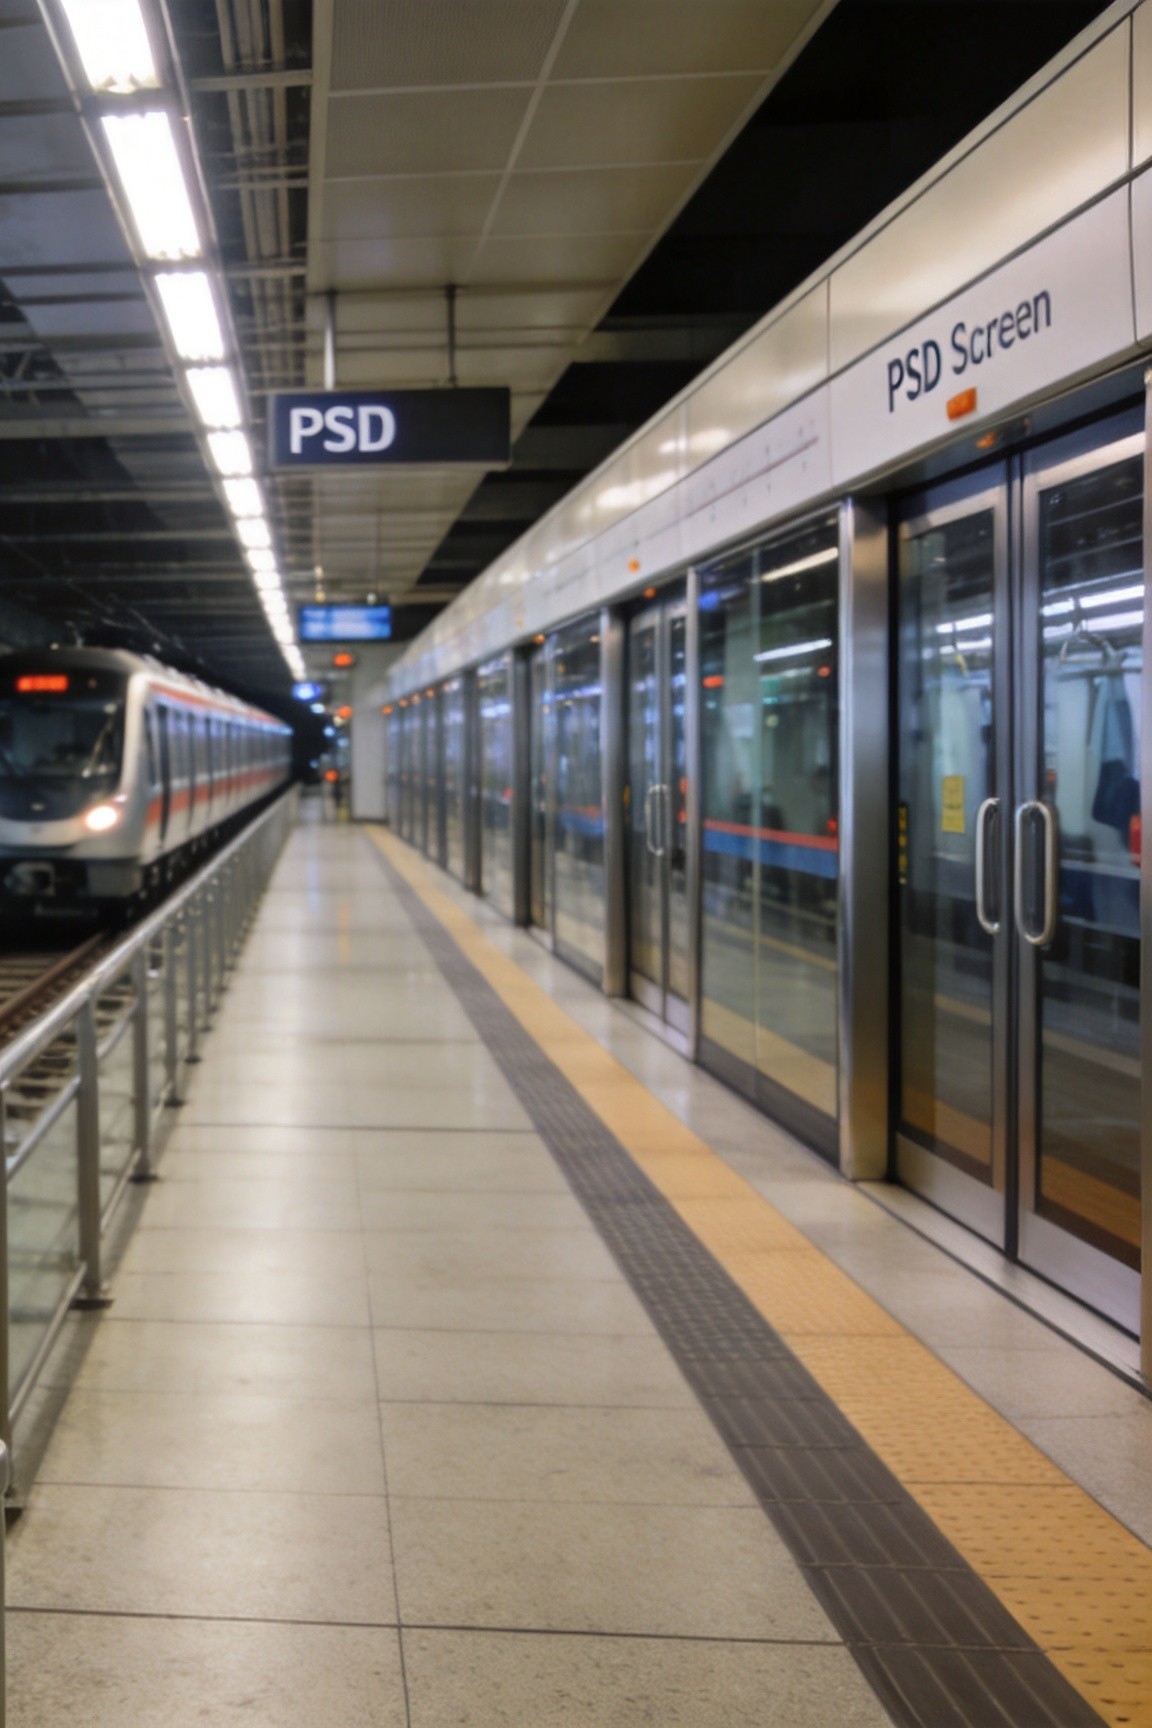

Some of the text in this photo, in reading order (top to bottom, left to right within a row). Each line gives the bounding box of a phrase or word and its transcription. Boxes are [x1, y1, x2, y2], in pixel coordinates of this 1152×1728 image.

[887, 289, 1051, 413] PSD Screen
[290, 404, 397, 454] PSD
